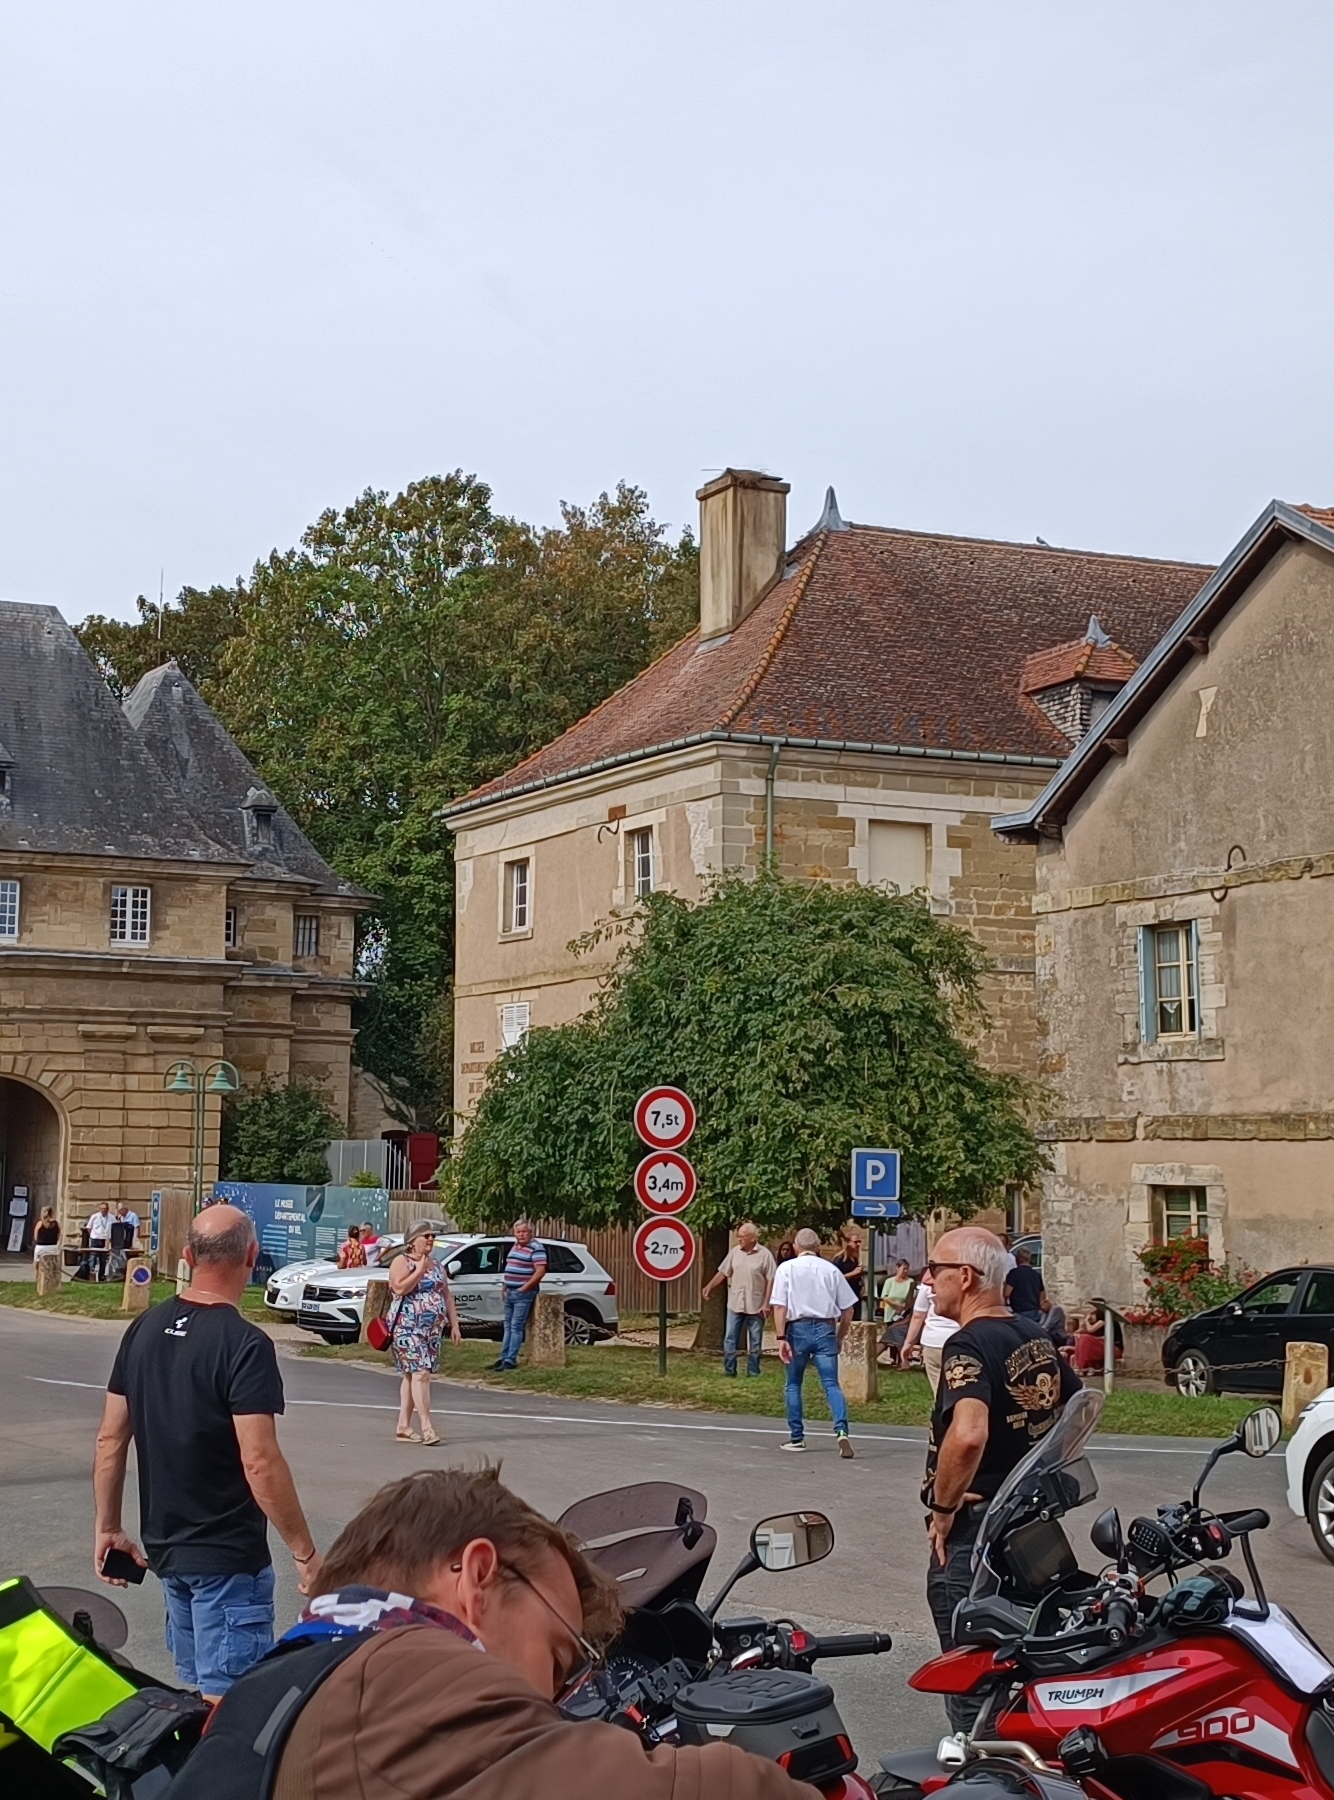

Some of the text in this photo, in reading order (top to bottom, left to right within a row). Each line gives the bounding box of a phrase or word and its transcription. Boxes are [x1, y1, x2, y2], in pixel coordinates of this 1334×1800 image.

[650, 1110, 680, 1129] 7,5t
[866, 1159, 886, 1190] P
[647, 1175, 684, 1193] 3,4m
[650, 1241, 679, 1256] 2,7m
[454, 1294, 483, 1303] KODA
[1047, 1687, 1105, 1704] TRIUMPH
[1177, 1711, 1256, 1740] 900
